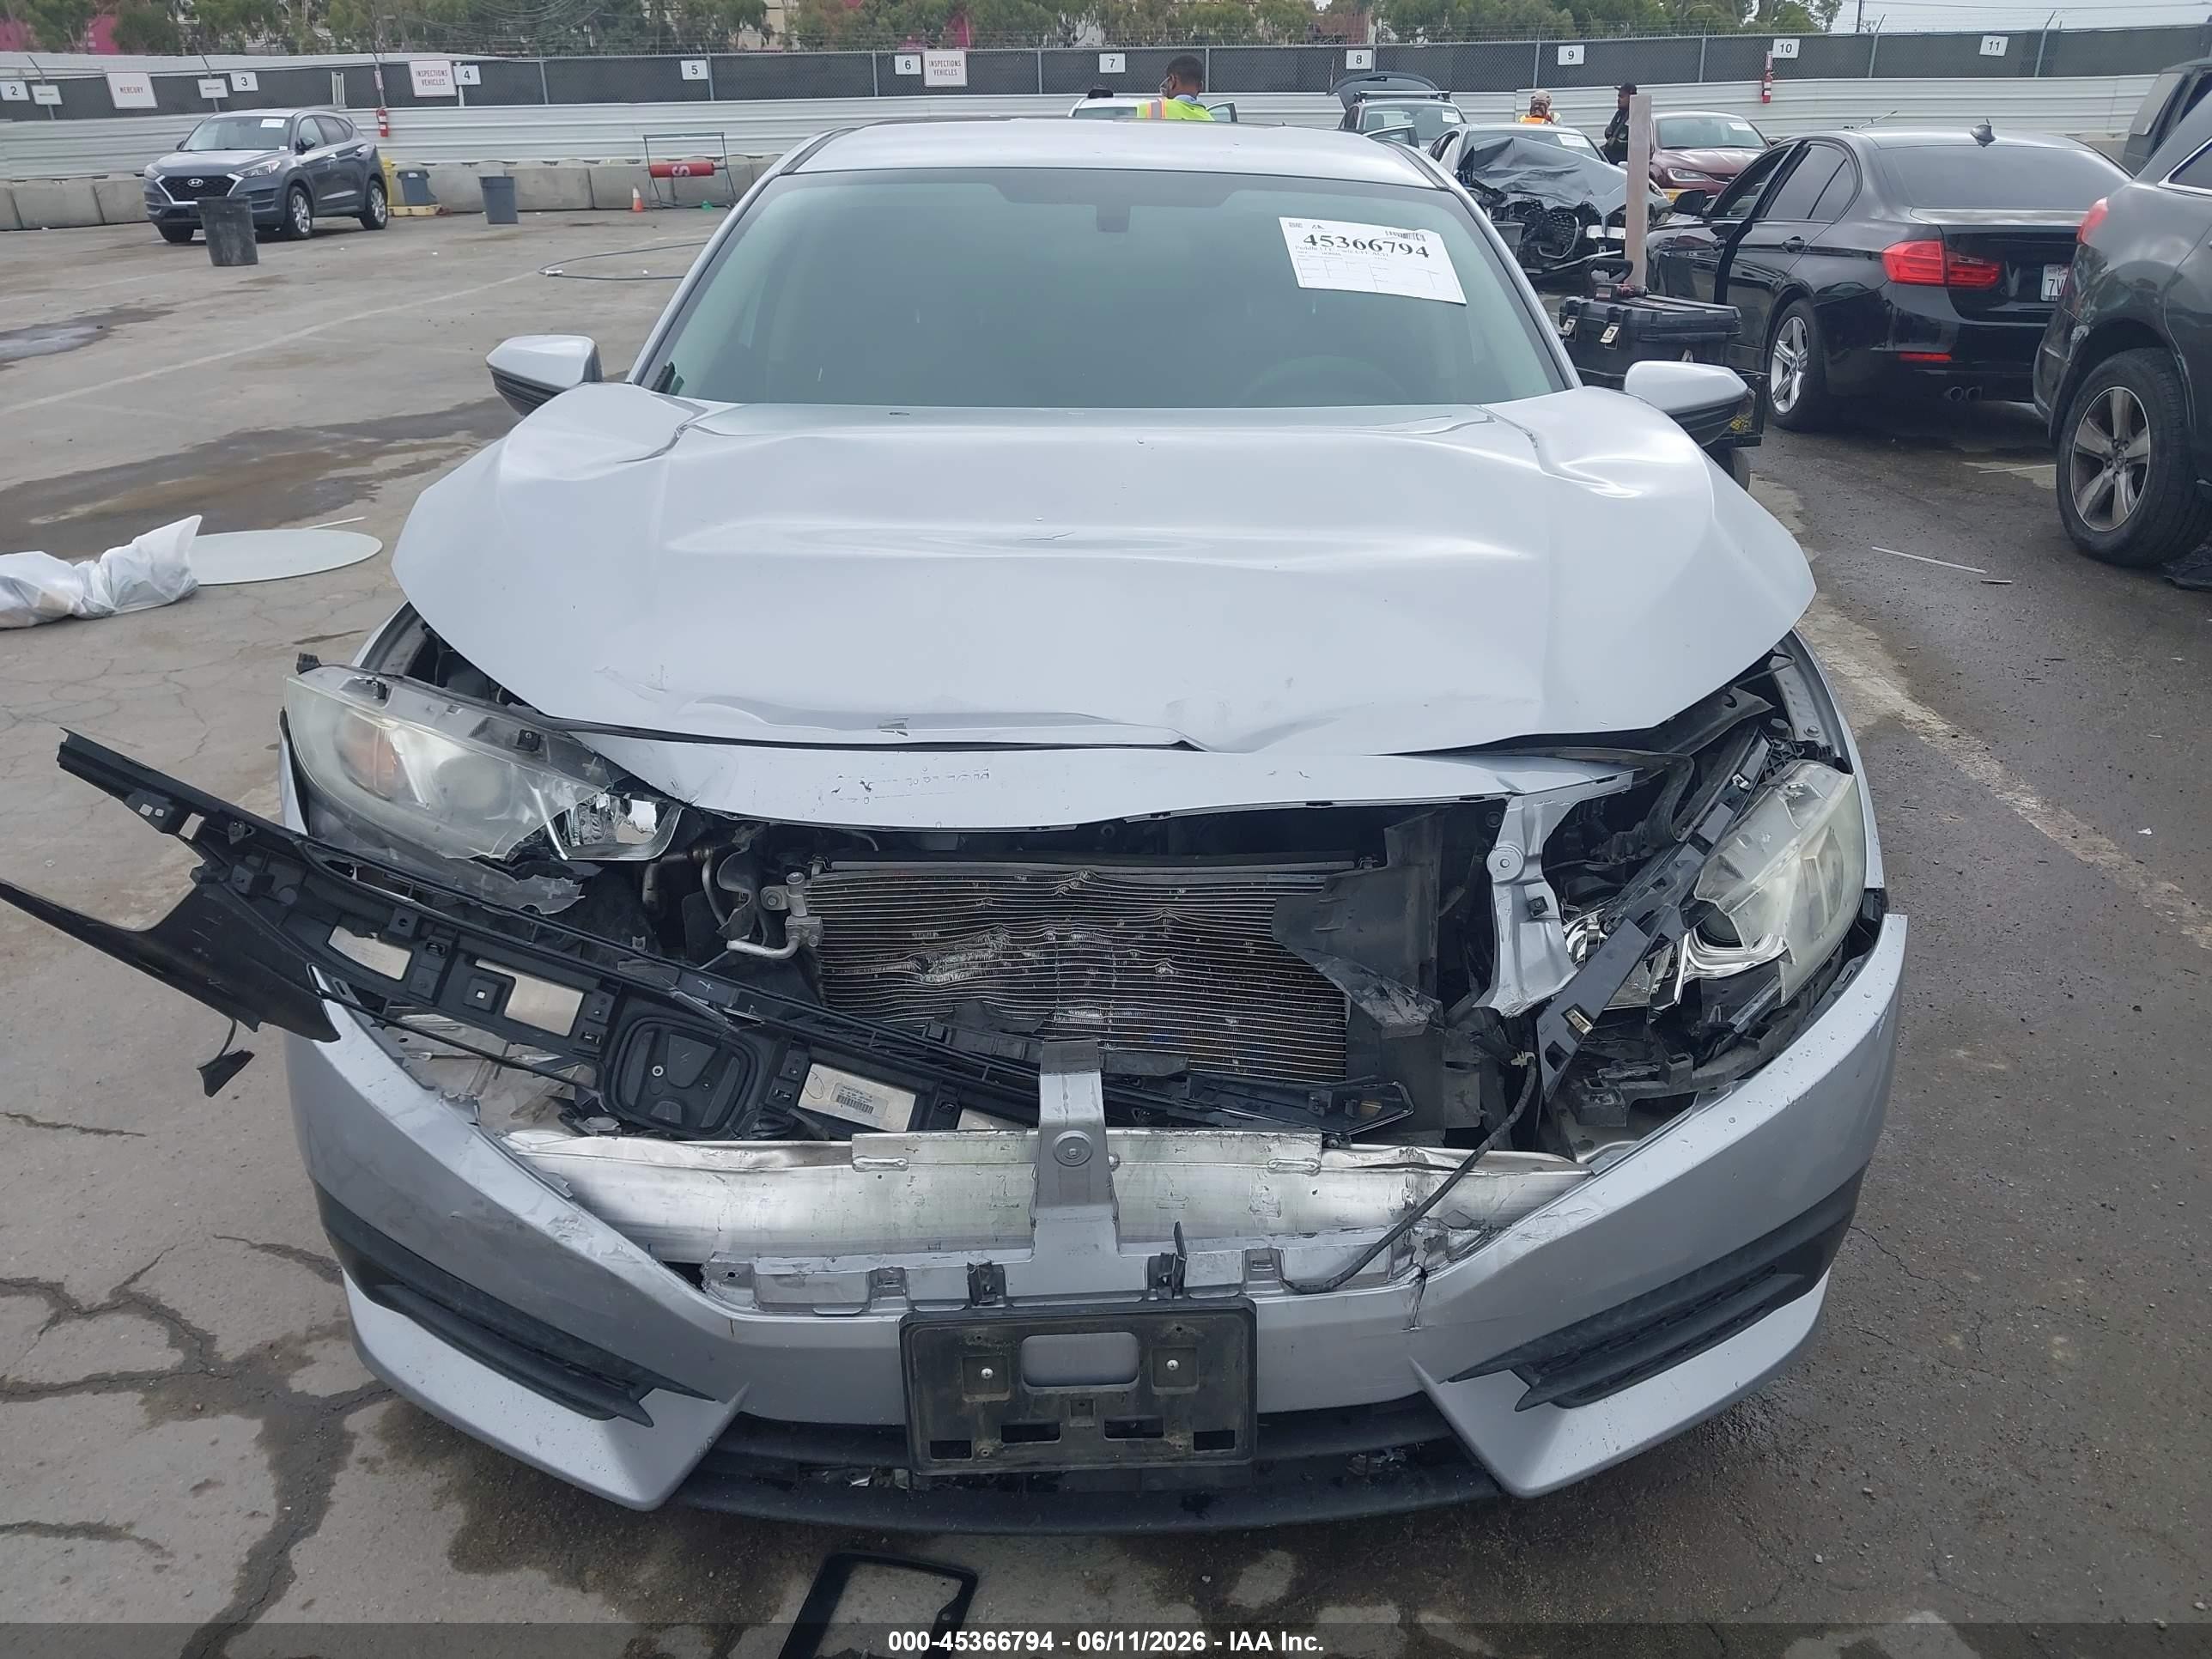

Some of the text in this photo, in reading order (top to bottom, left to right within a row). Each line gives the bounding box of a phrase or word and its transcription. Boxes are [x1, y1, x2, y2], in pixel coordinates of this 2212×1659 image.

[1779, 43, 1793, 53] 10
[1988, 41, 2001, 51] 11
[1356, 54, 1363, 64] 8
[1568, 51, 1575, 60] 9
[904, 60, 912, 70] 6
[1109, 58, 1116, 68] 7
[691, 64, 699, 76] 5
[464, 70, 471, 81] 4
[240, 76, 248, 87] 3
[10, 86, 18, 96] 2
[119, 86, 144, 94] MERCURY
[1304, 234, 1430, 258] 45366794
